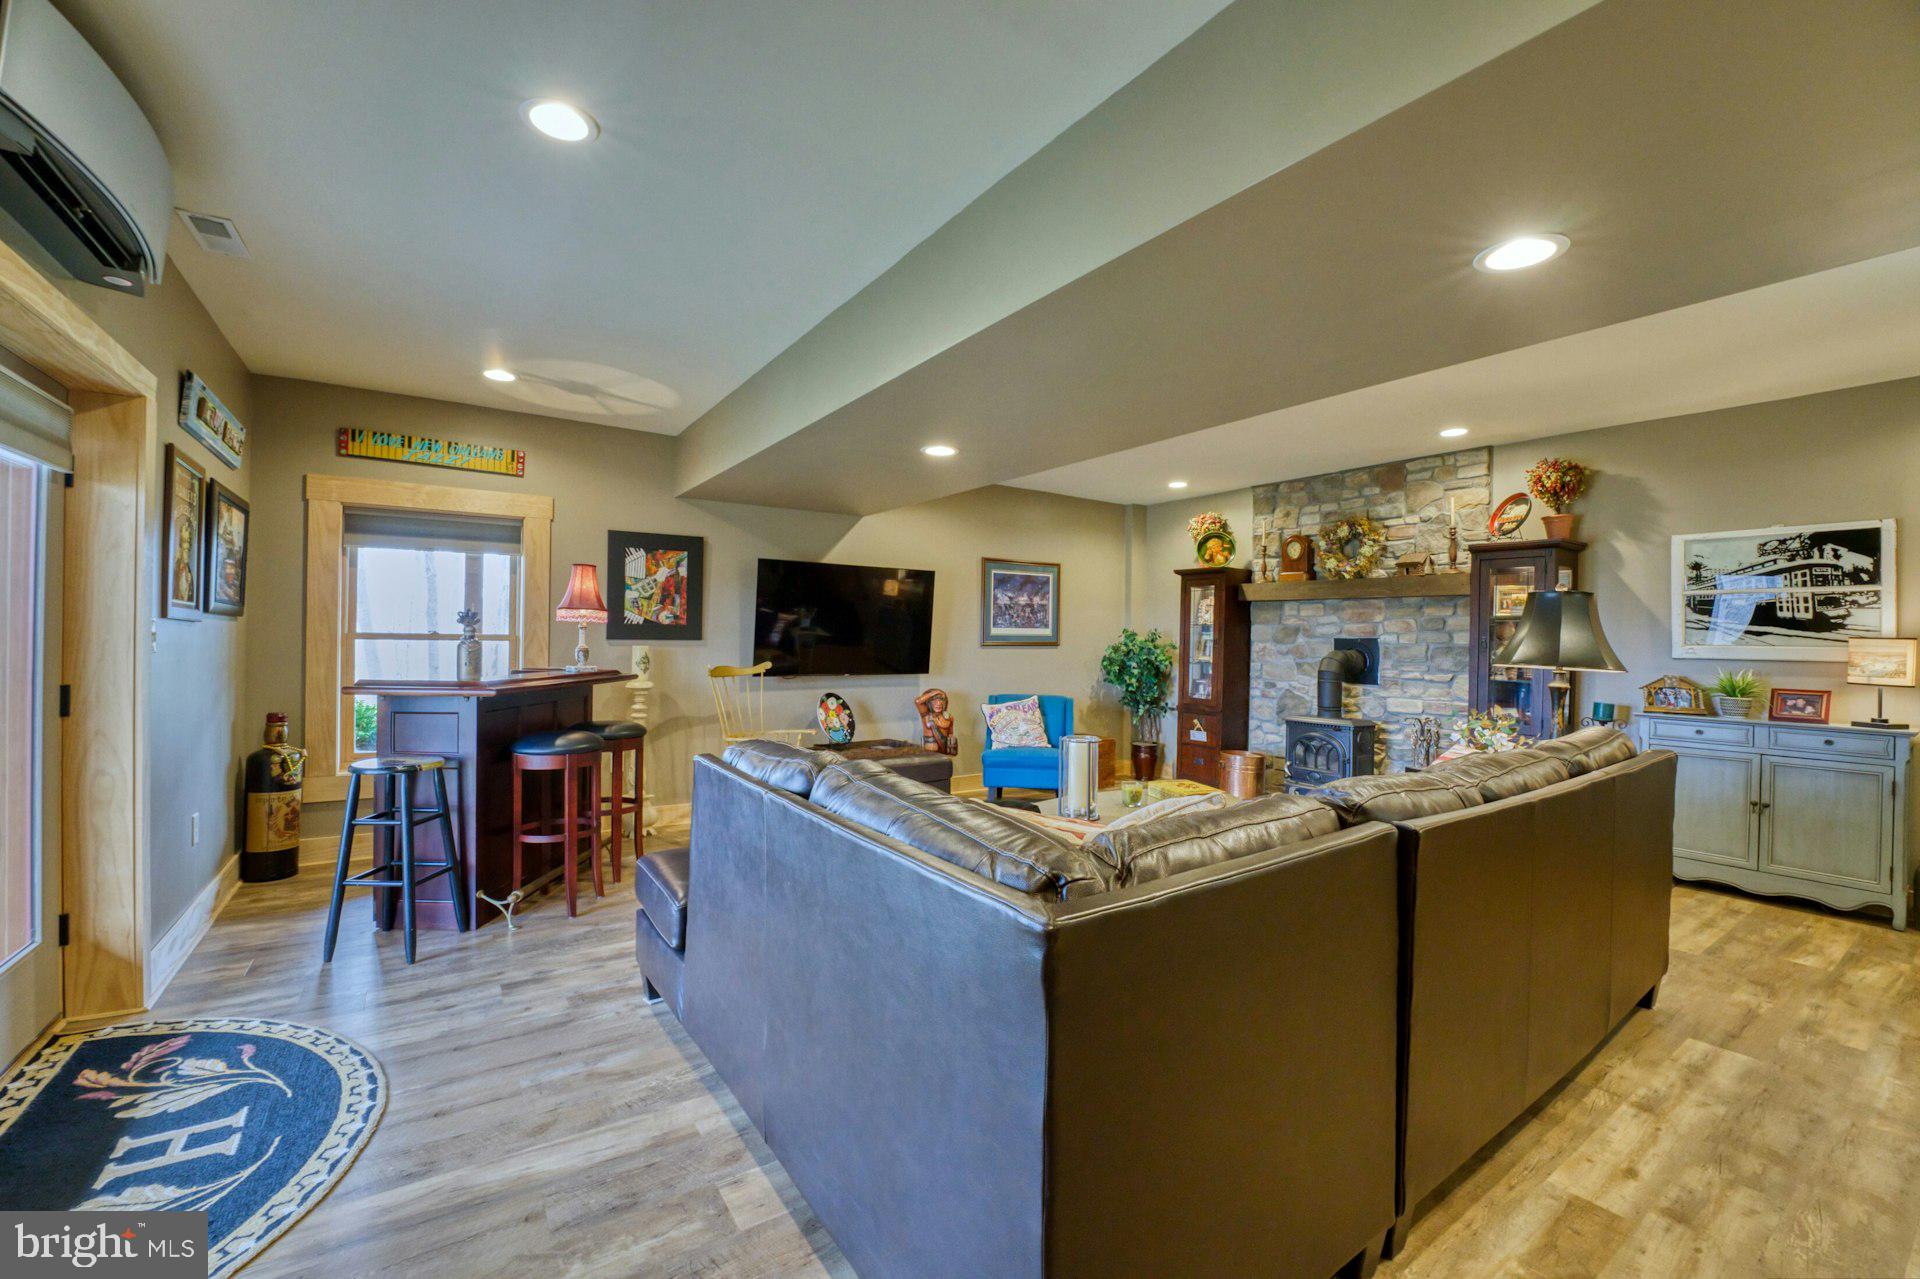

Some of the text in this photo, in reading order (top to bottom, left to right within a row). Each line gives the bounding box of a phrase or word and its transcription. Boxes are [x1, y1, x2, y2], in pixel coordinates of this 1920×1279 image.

[358, 430, 365, 443] I
[371, 432, 405, 448] LOVE
[413, 440, 443, 453] NEW
